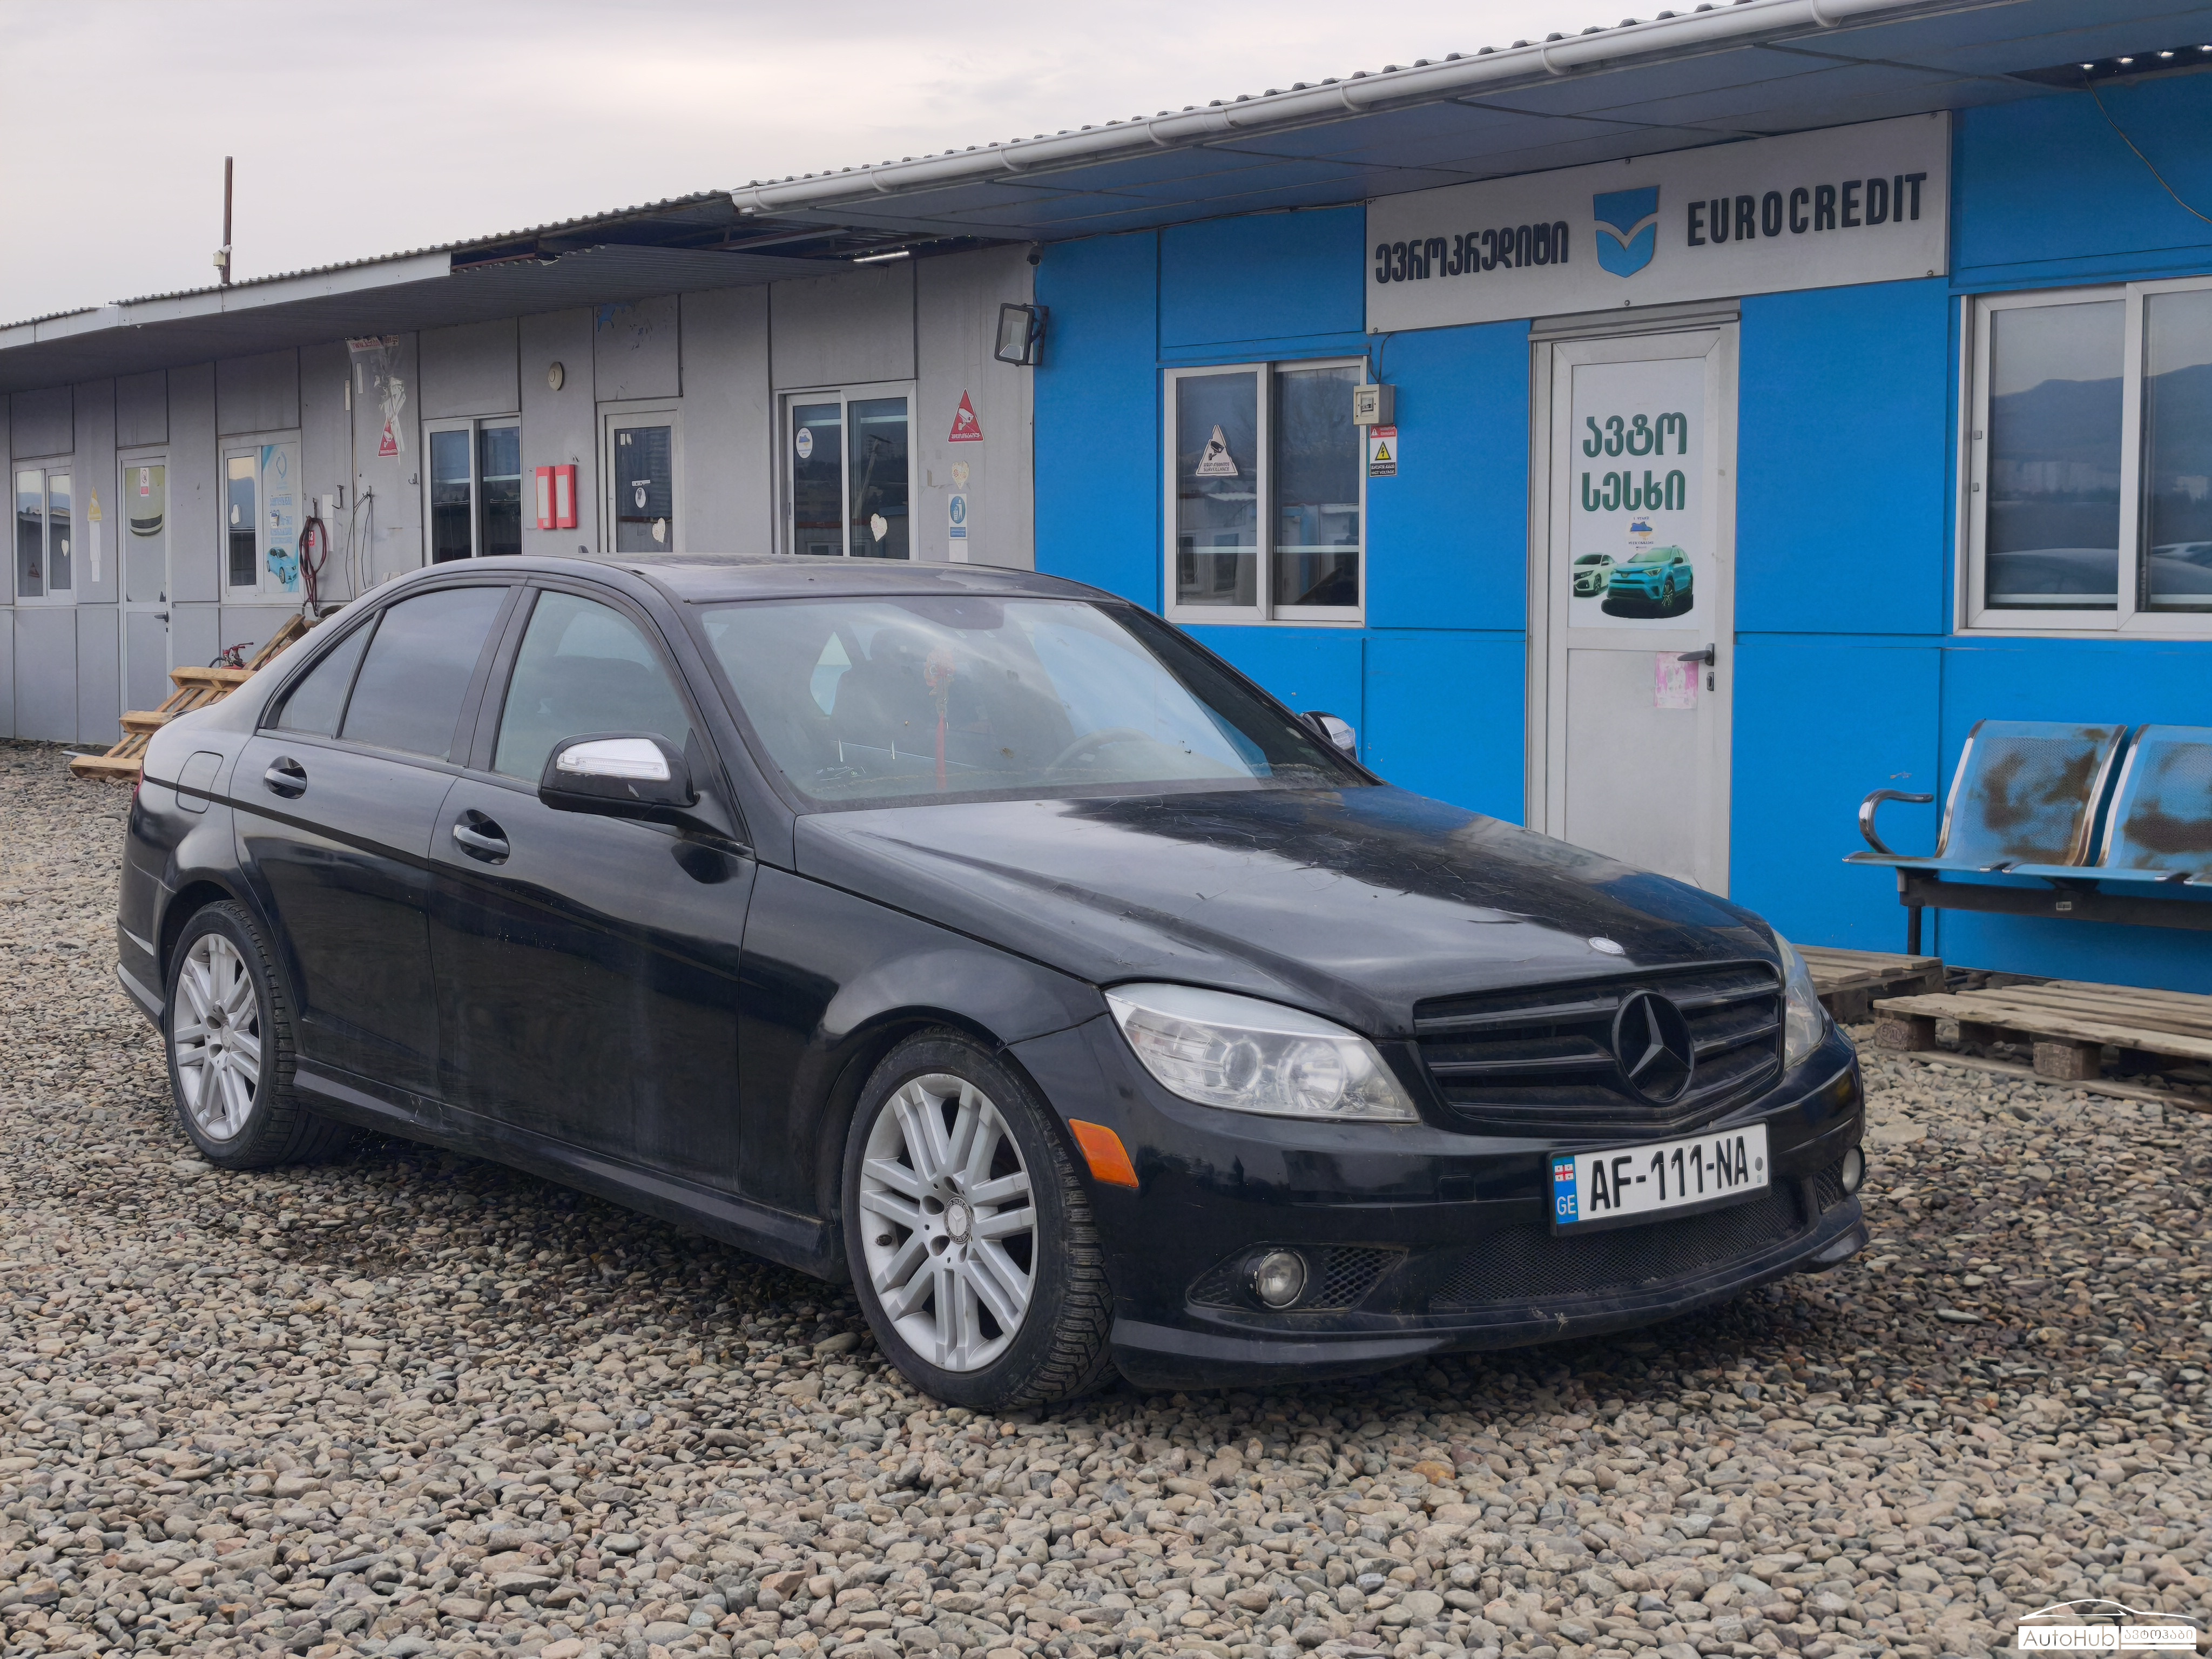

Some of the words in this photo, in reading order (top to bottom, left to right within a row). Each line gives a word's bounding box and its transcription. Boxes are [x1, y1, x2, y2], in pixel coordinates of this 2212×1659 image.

[1688, 172, 1927, 247] EUROCREDIT
[1375, 221, 1568, 284] ევროკრედიტი
[1583, 412, 1687, 457] ავტო
[1582, 469, 1685, 511] სესხი
[1590, 1136, 1749, 1211] AF-111-NA
[1556, 1194, 1576, 1216] GE
